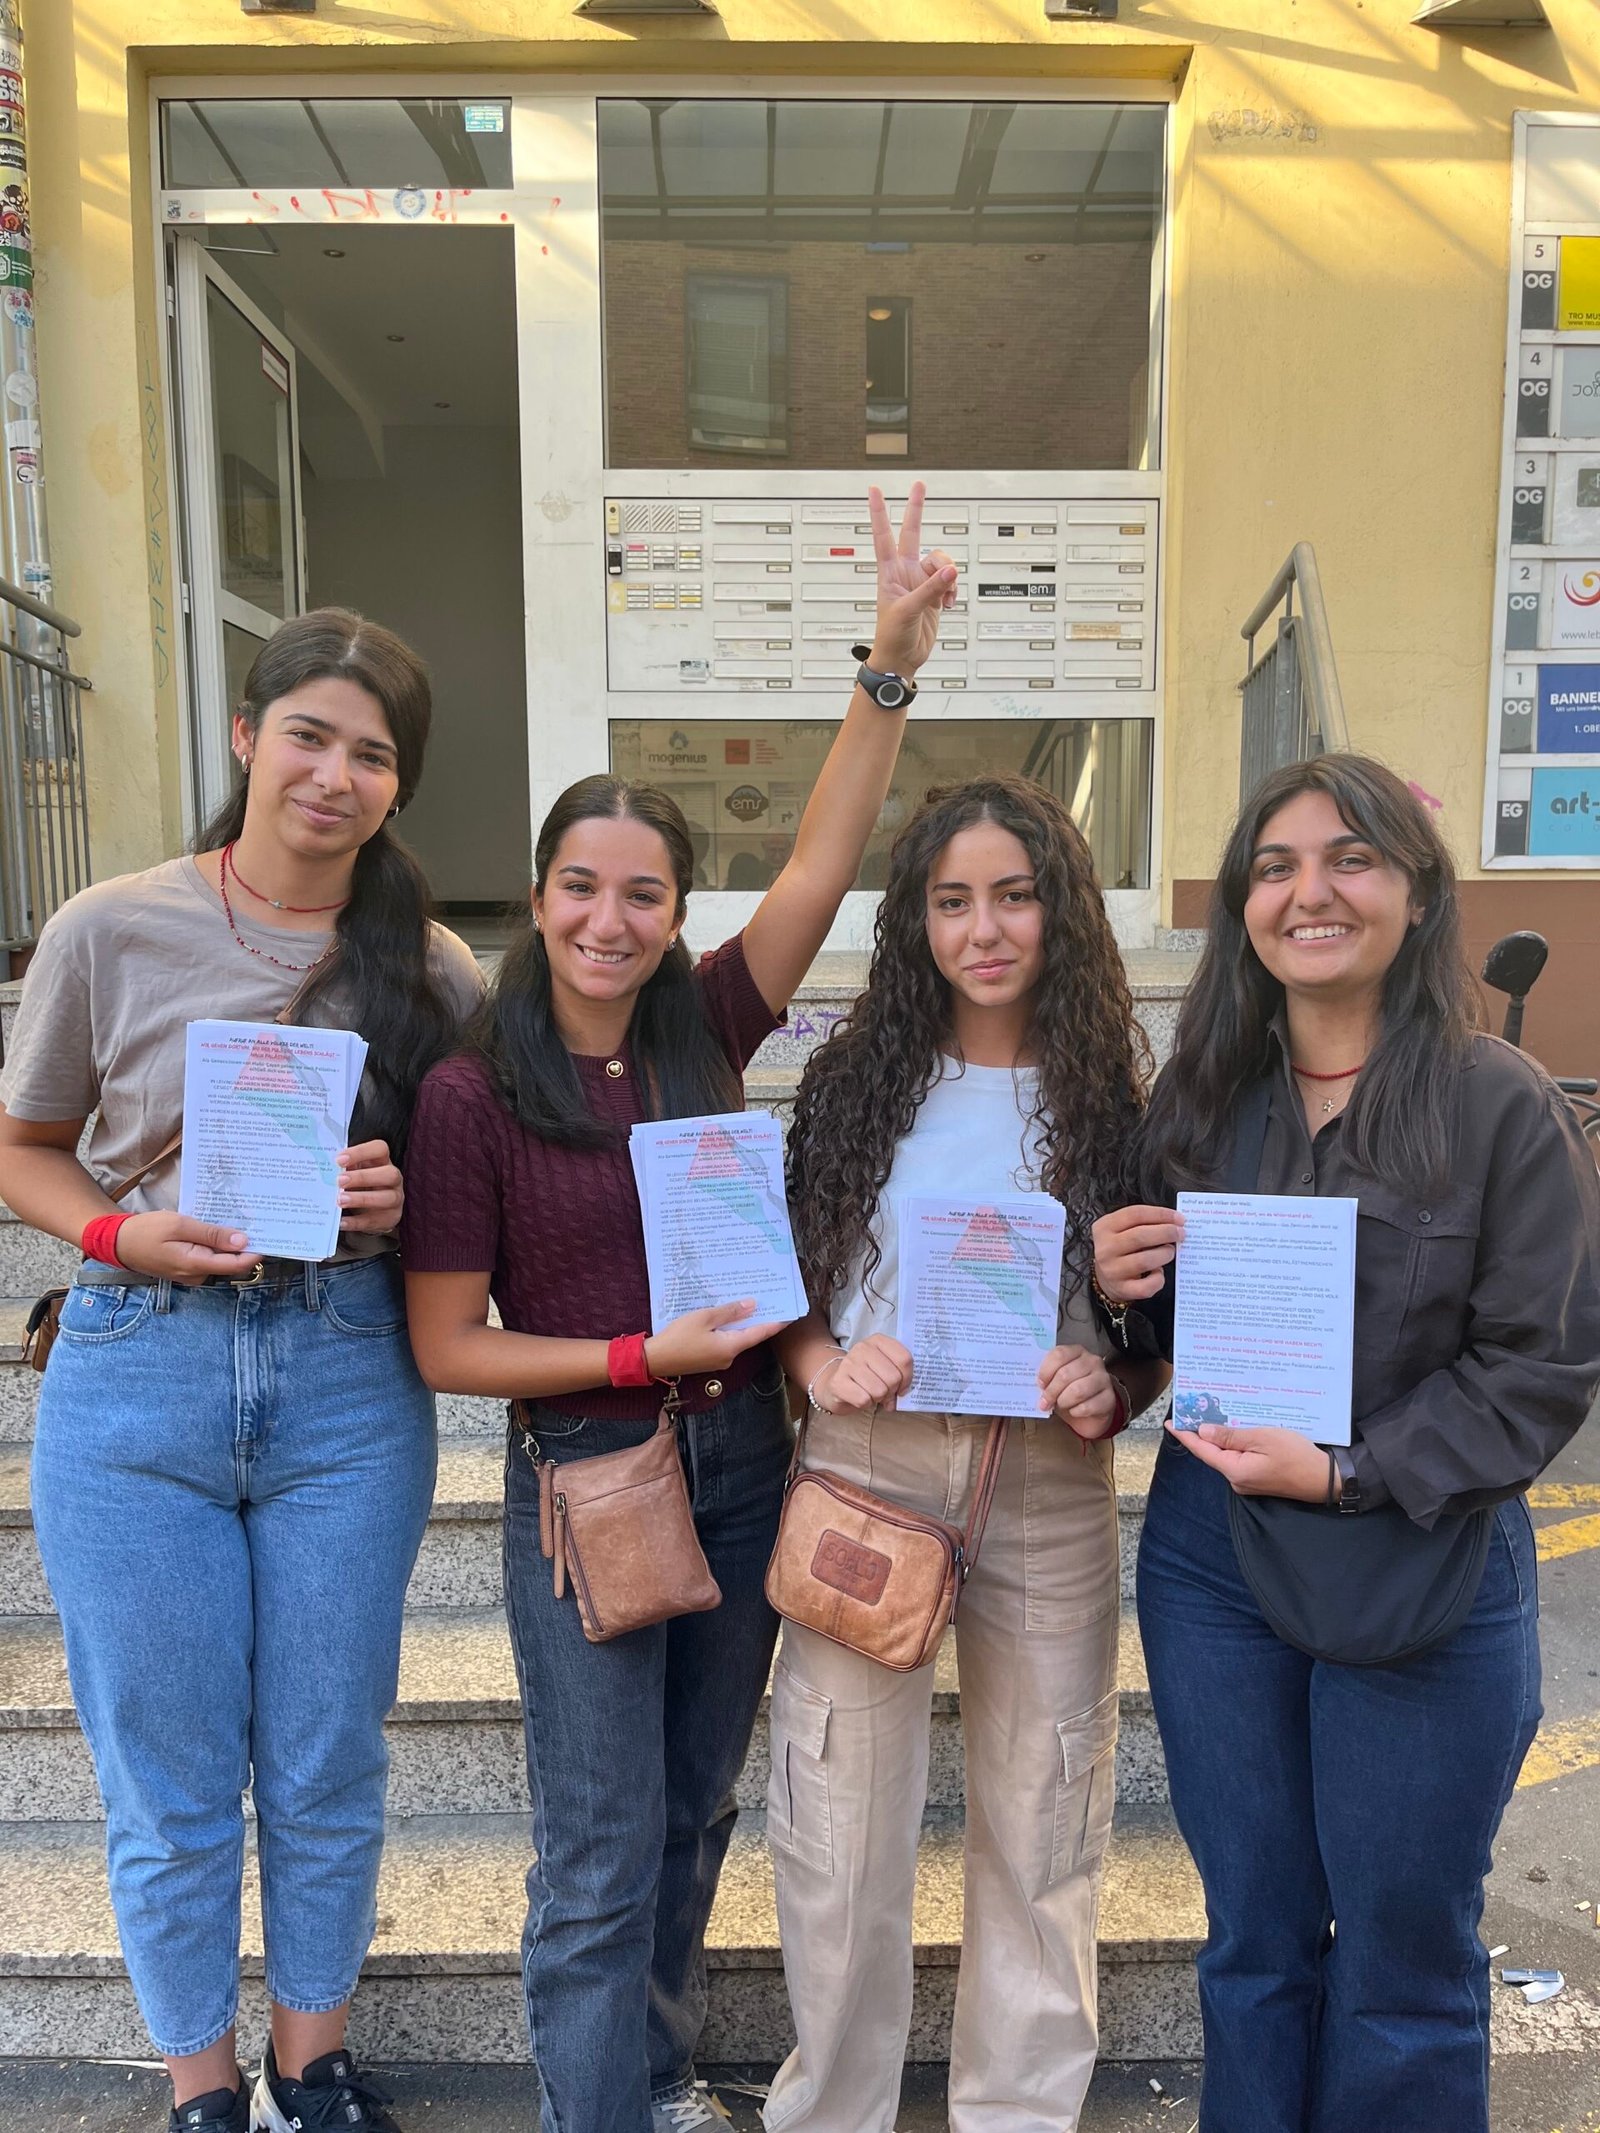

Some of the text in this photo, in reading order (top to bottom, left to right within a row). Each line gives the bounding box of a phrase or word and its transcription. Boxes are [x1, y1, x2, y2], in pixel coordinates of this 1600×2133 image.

[1534, 244, 1545, 259] 5
[1524, 273, 1553, 289] OG
[1530, 352, 1542, 366] 4
[1520, 381, 1549, 397] OG
[1525, 460, 1536, 474] 3
[1515, 489, 1543, 505] OG
[1520, 566, 1530, 580] 2
[1509, 595, 1538, 611] OG
[1517, 672, 1522, 685] 1
[1503, 700, 1532, 715] OG
[648, 753, 707, 766] mogenius
[731, 799, 762, 810] ems
[1502, 803, 1523, 818] EG
